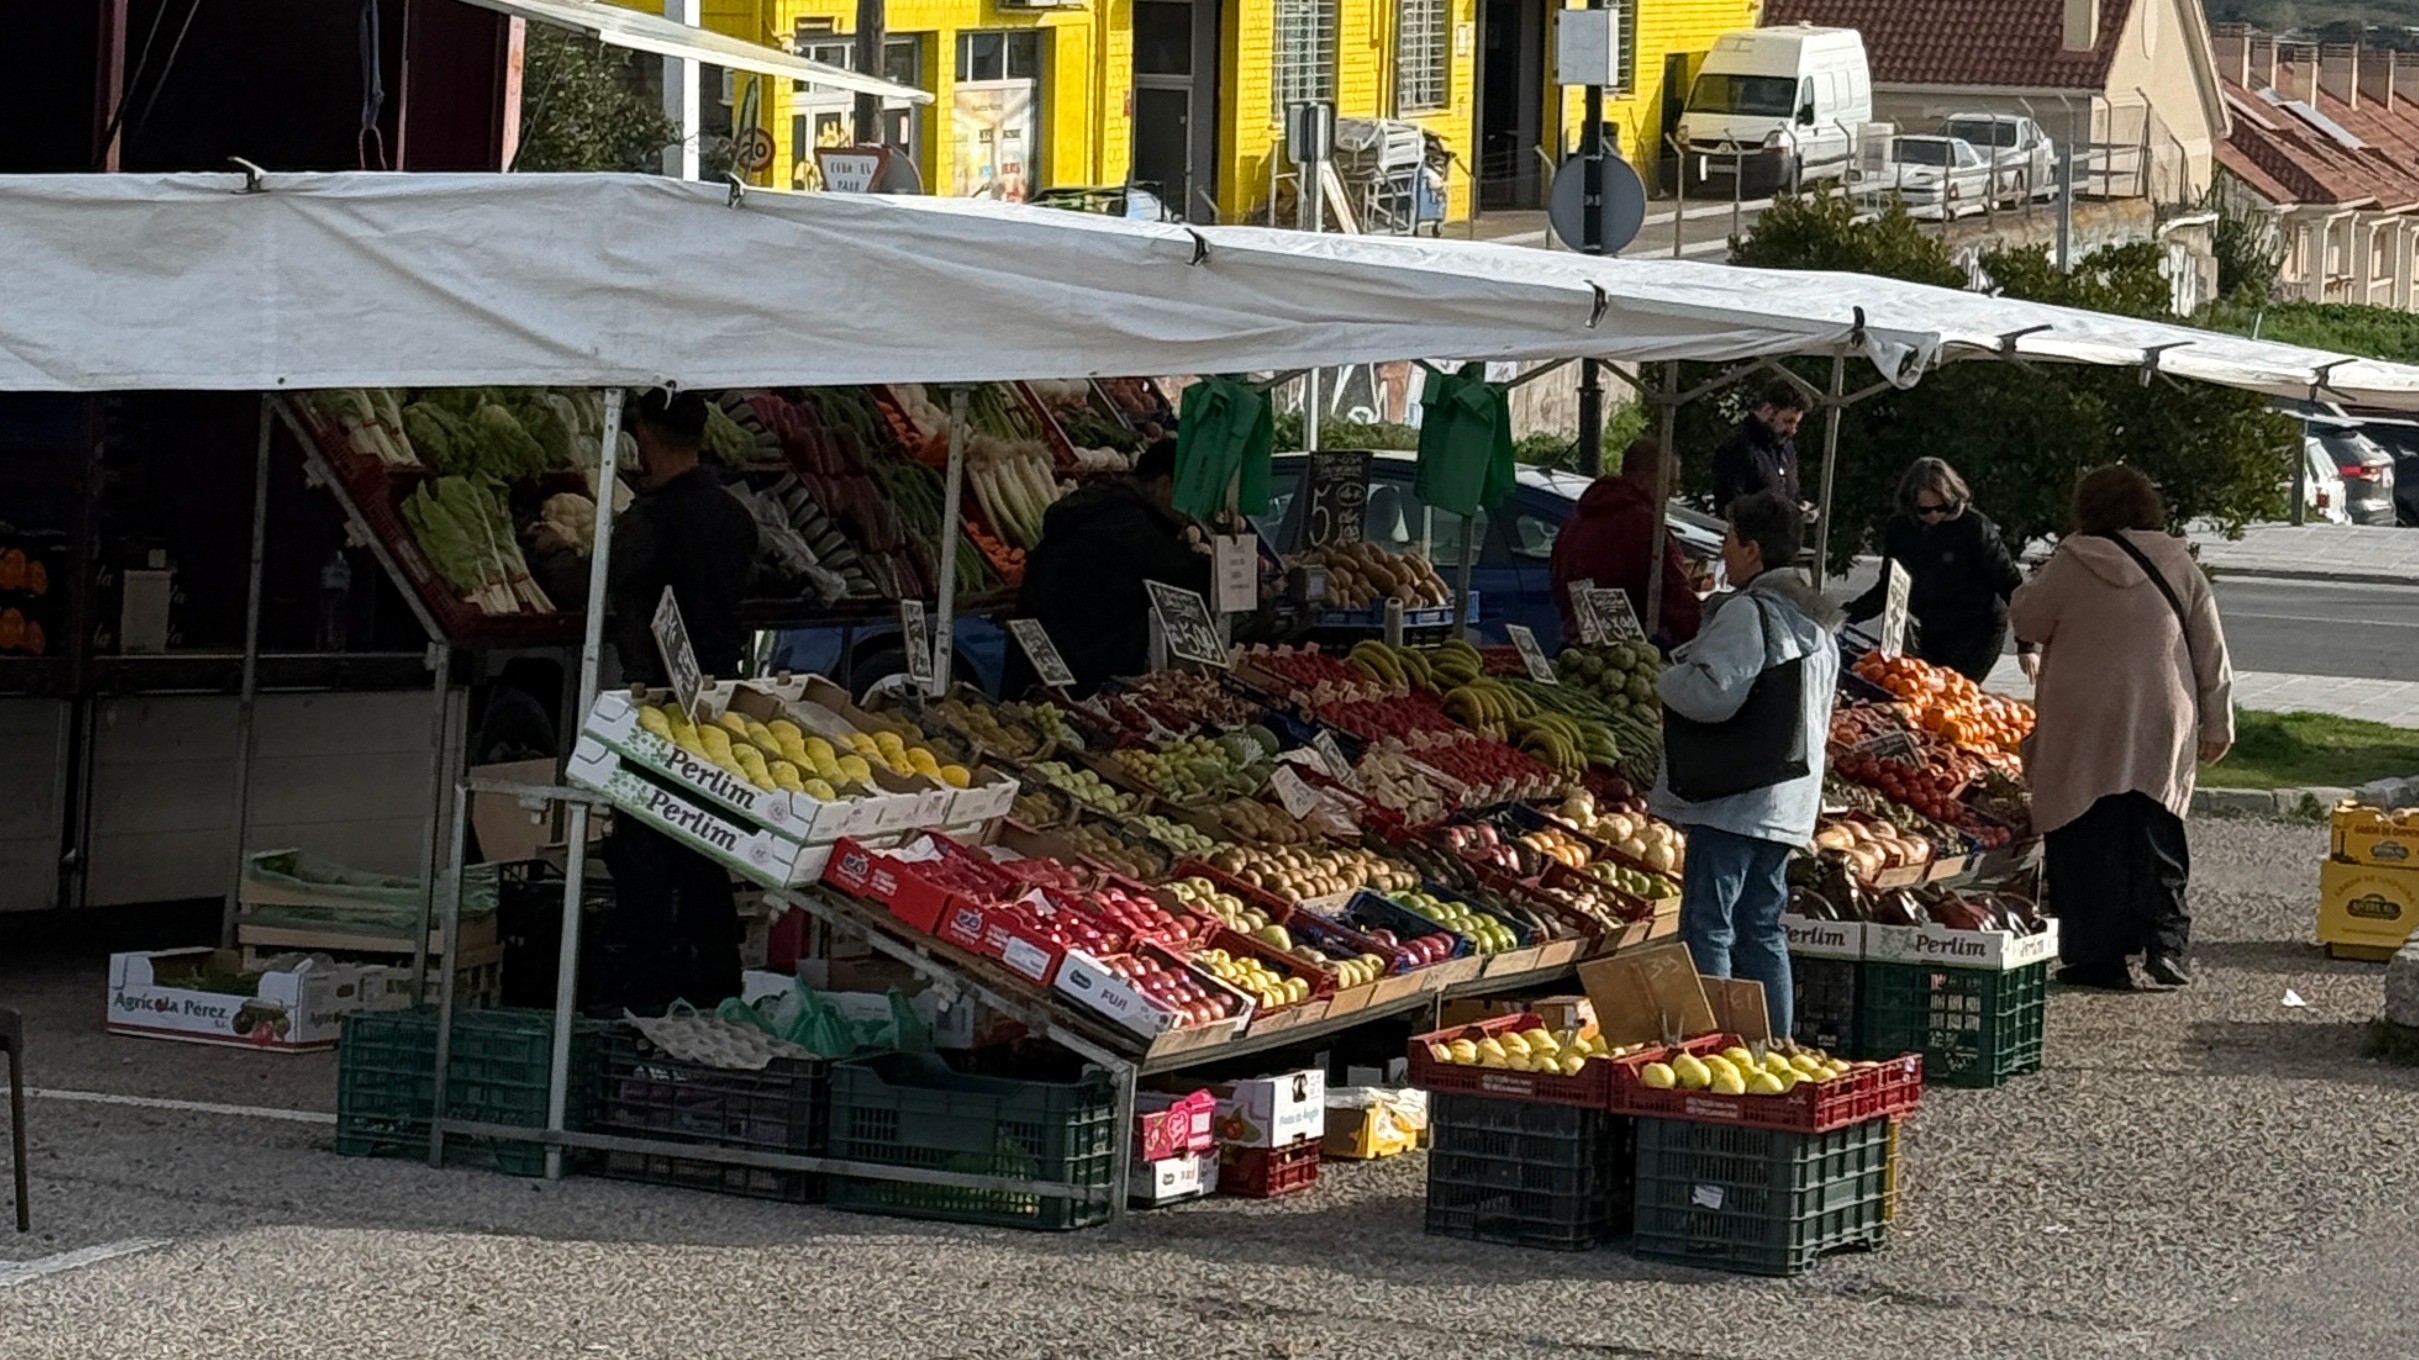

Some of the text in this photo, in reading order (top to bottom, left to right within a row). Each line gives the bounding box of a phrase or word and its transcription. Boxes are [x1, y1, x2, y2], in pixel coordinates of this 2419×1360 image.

[664, 745, 757, 810] Perlim
[645, 788, 739, 853] Perlim
[1914, 933, 1987, 958] Perlim
[113, 991, 179, 1013] Agrícola
[1100, 988, 1128, 1011] FUJI
